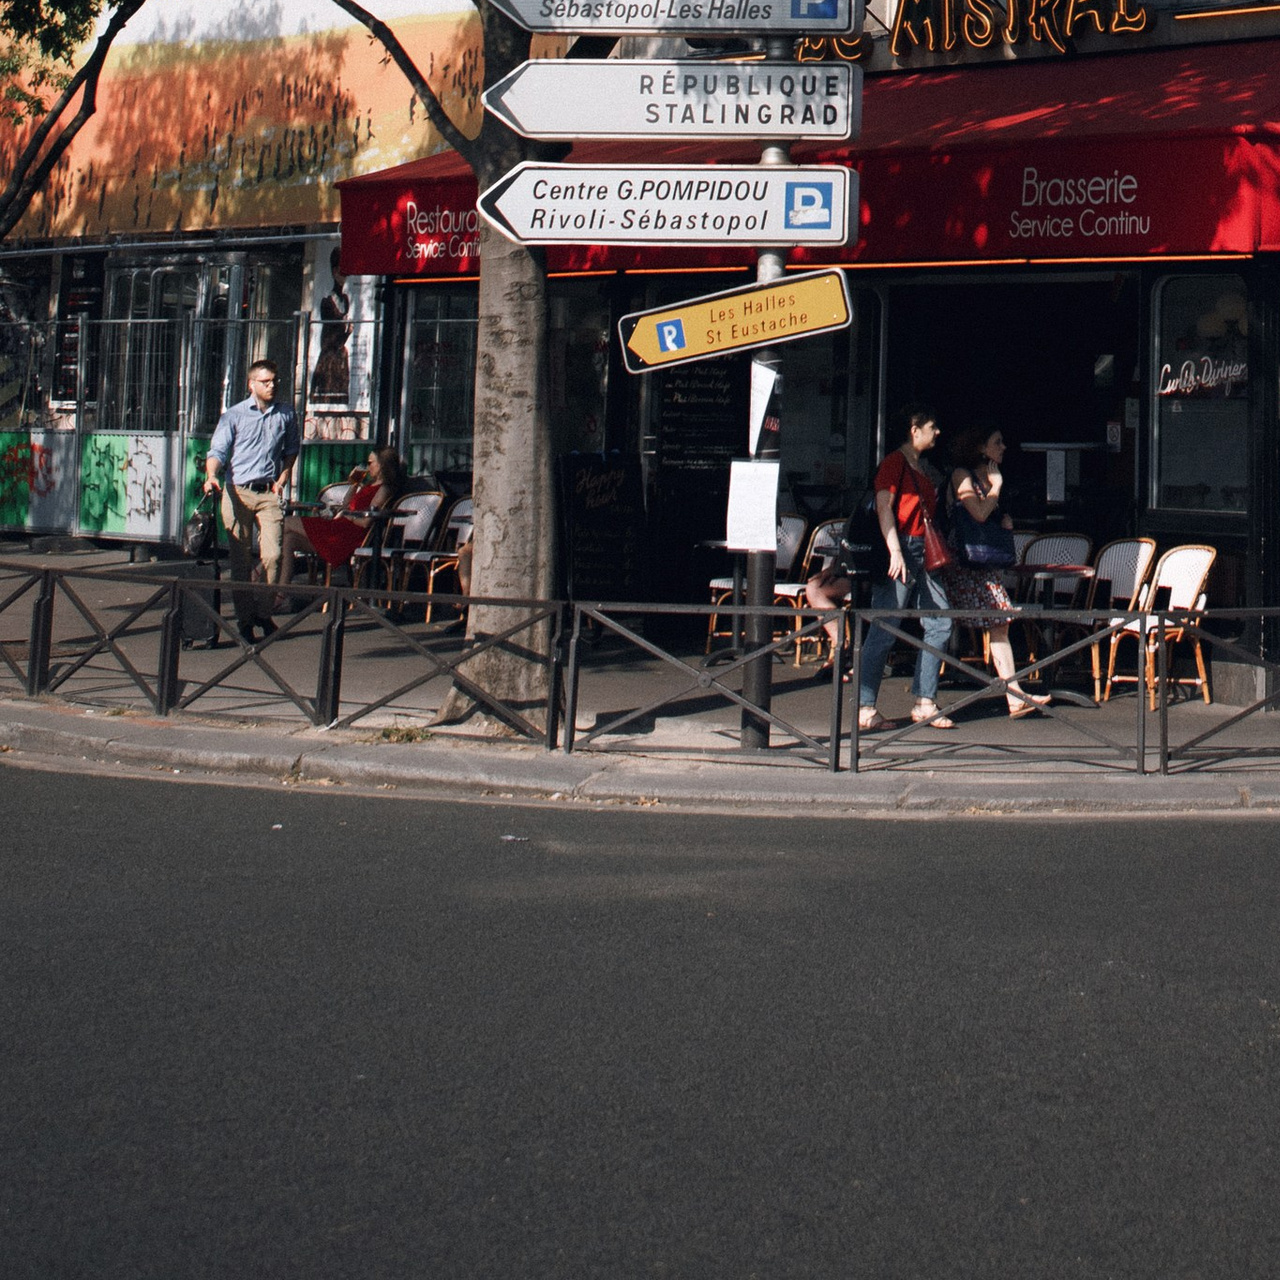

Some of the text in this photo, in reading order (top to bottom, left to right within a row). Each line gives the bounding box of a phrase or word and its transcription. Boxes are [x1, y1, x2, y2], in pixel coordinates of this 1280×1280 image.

[708, 0, 772, 19] Halles
[640, 70, 839, 97] RÉPUBLIQUE
[645, 103, 838, 126] STALINGRAD
[532, 179, 769, 201] Centre G.POMPIDOU
[1022, 167, 1138, 206] Brasserie
[530, 209, 768, 235] Rivoli-Sébastopol
[1009, 209, 1150, 238] Service Continu
[406, 236, 446, 258] Service
[709, 293, 796, 324] Les Halles
[706, 311, 808, 345] St Eustache
